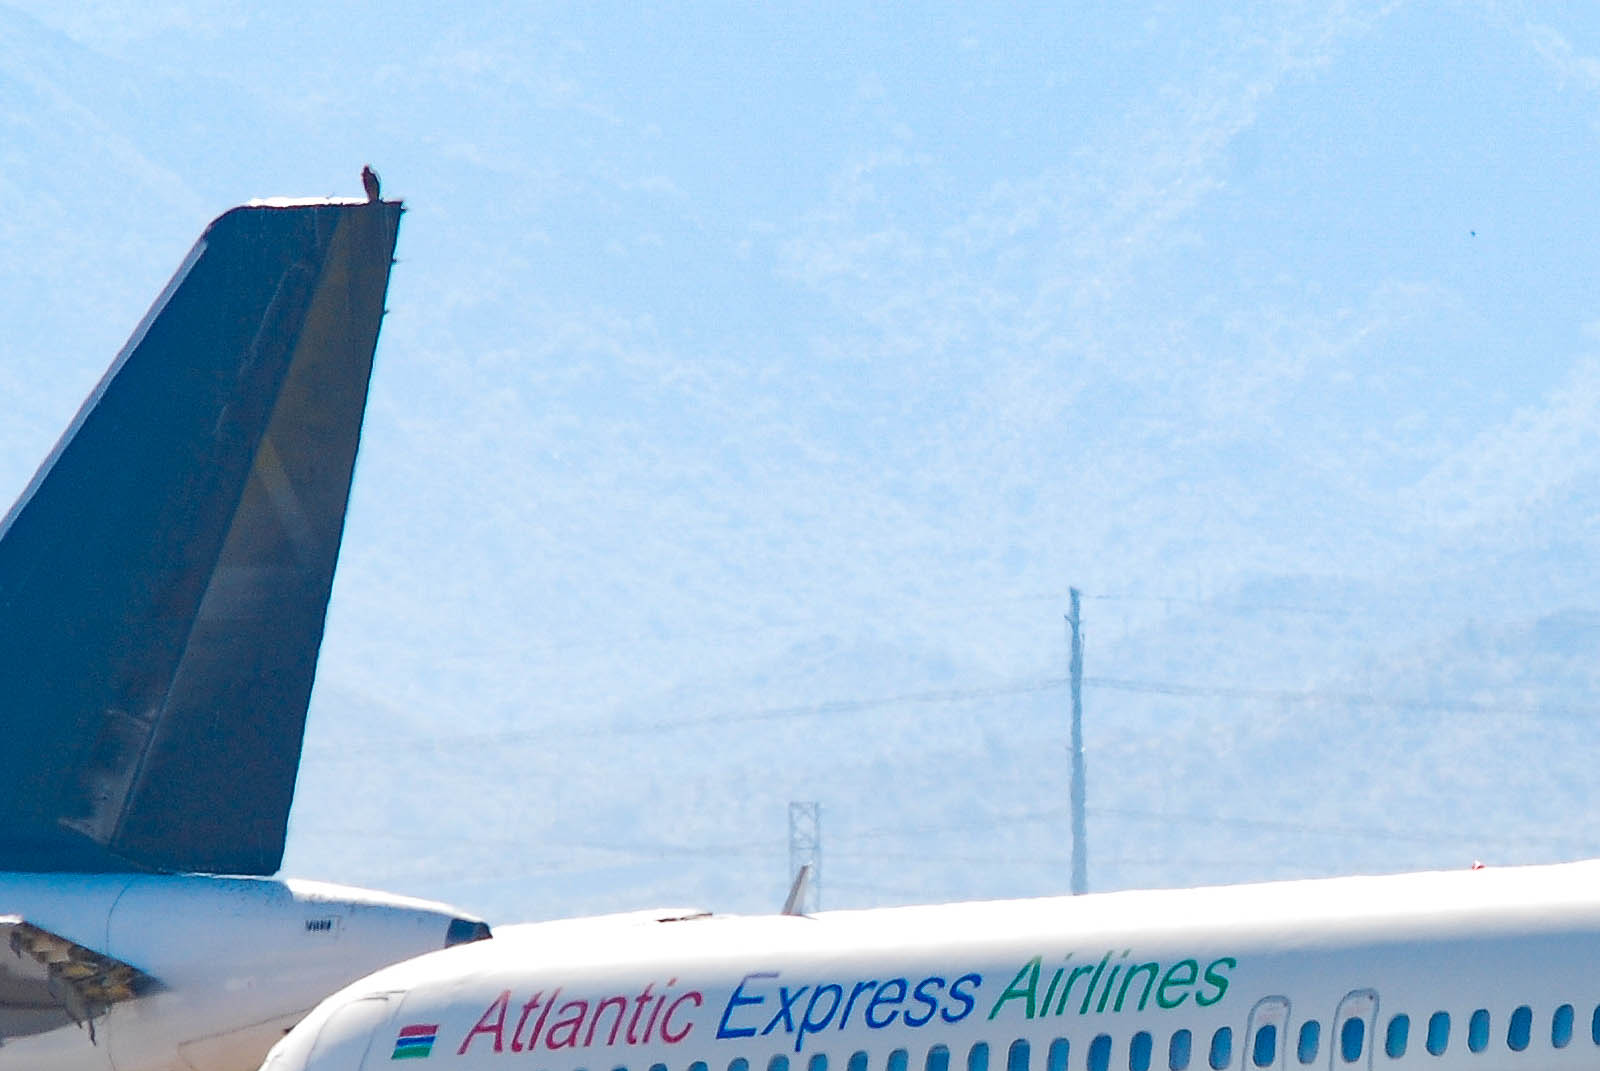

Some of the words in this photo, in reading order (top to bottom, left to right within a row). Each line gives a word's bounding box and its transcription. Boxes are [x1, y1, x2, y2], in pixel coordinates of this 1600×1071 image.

[456, 977, 703, 1056] Atlantic
[715, 971, 983, 1052] Express
[988, 948, 1238, 1022] Airlines
